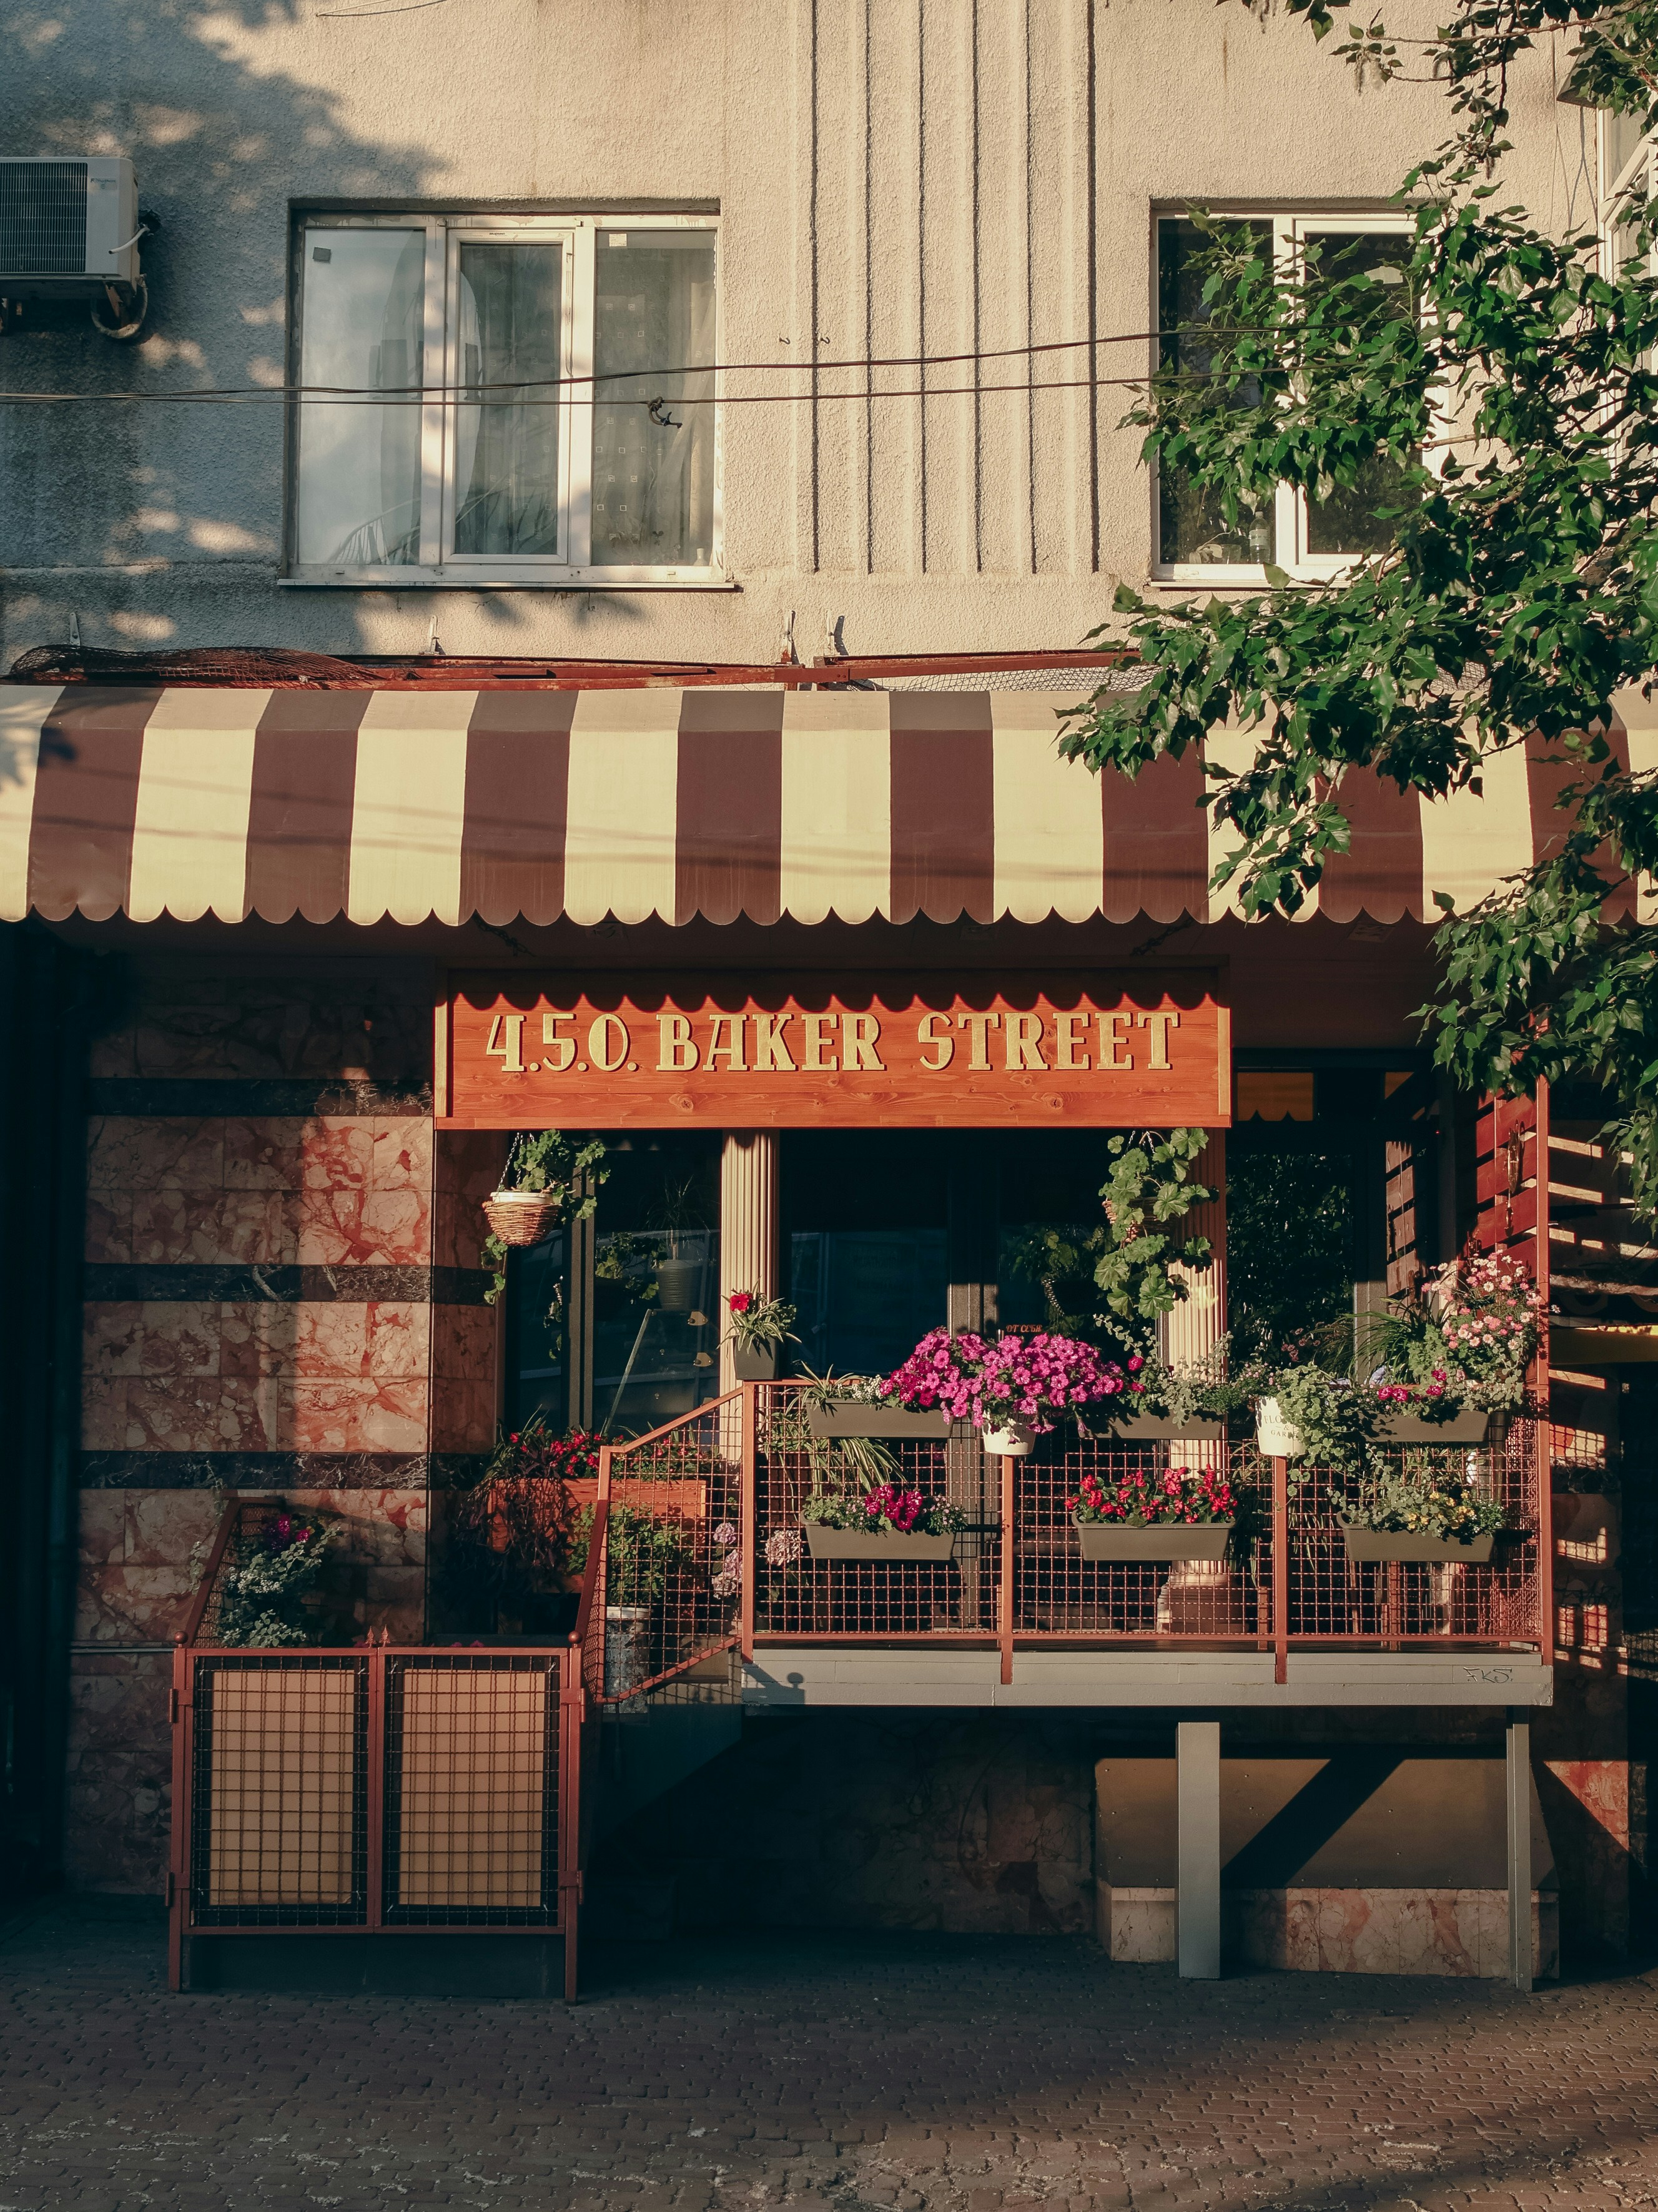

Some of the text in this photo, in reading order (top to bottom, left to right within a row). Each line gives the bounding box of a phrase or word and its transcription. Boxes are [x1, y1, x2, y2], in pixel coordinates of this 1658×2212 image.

[486, 1012, 1180, 1072] 4.5.0. BAKER STREET
[1005, 1324, 1042, 1333] ОТ СЕБЯ
